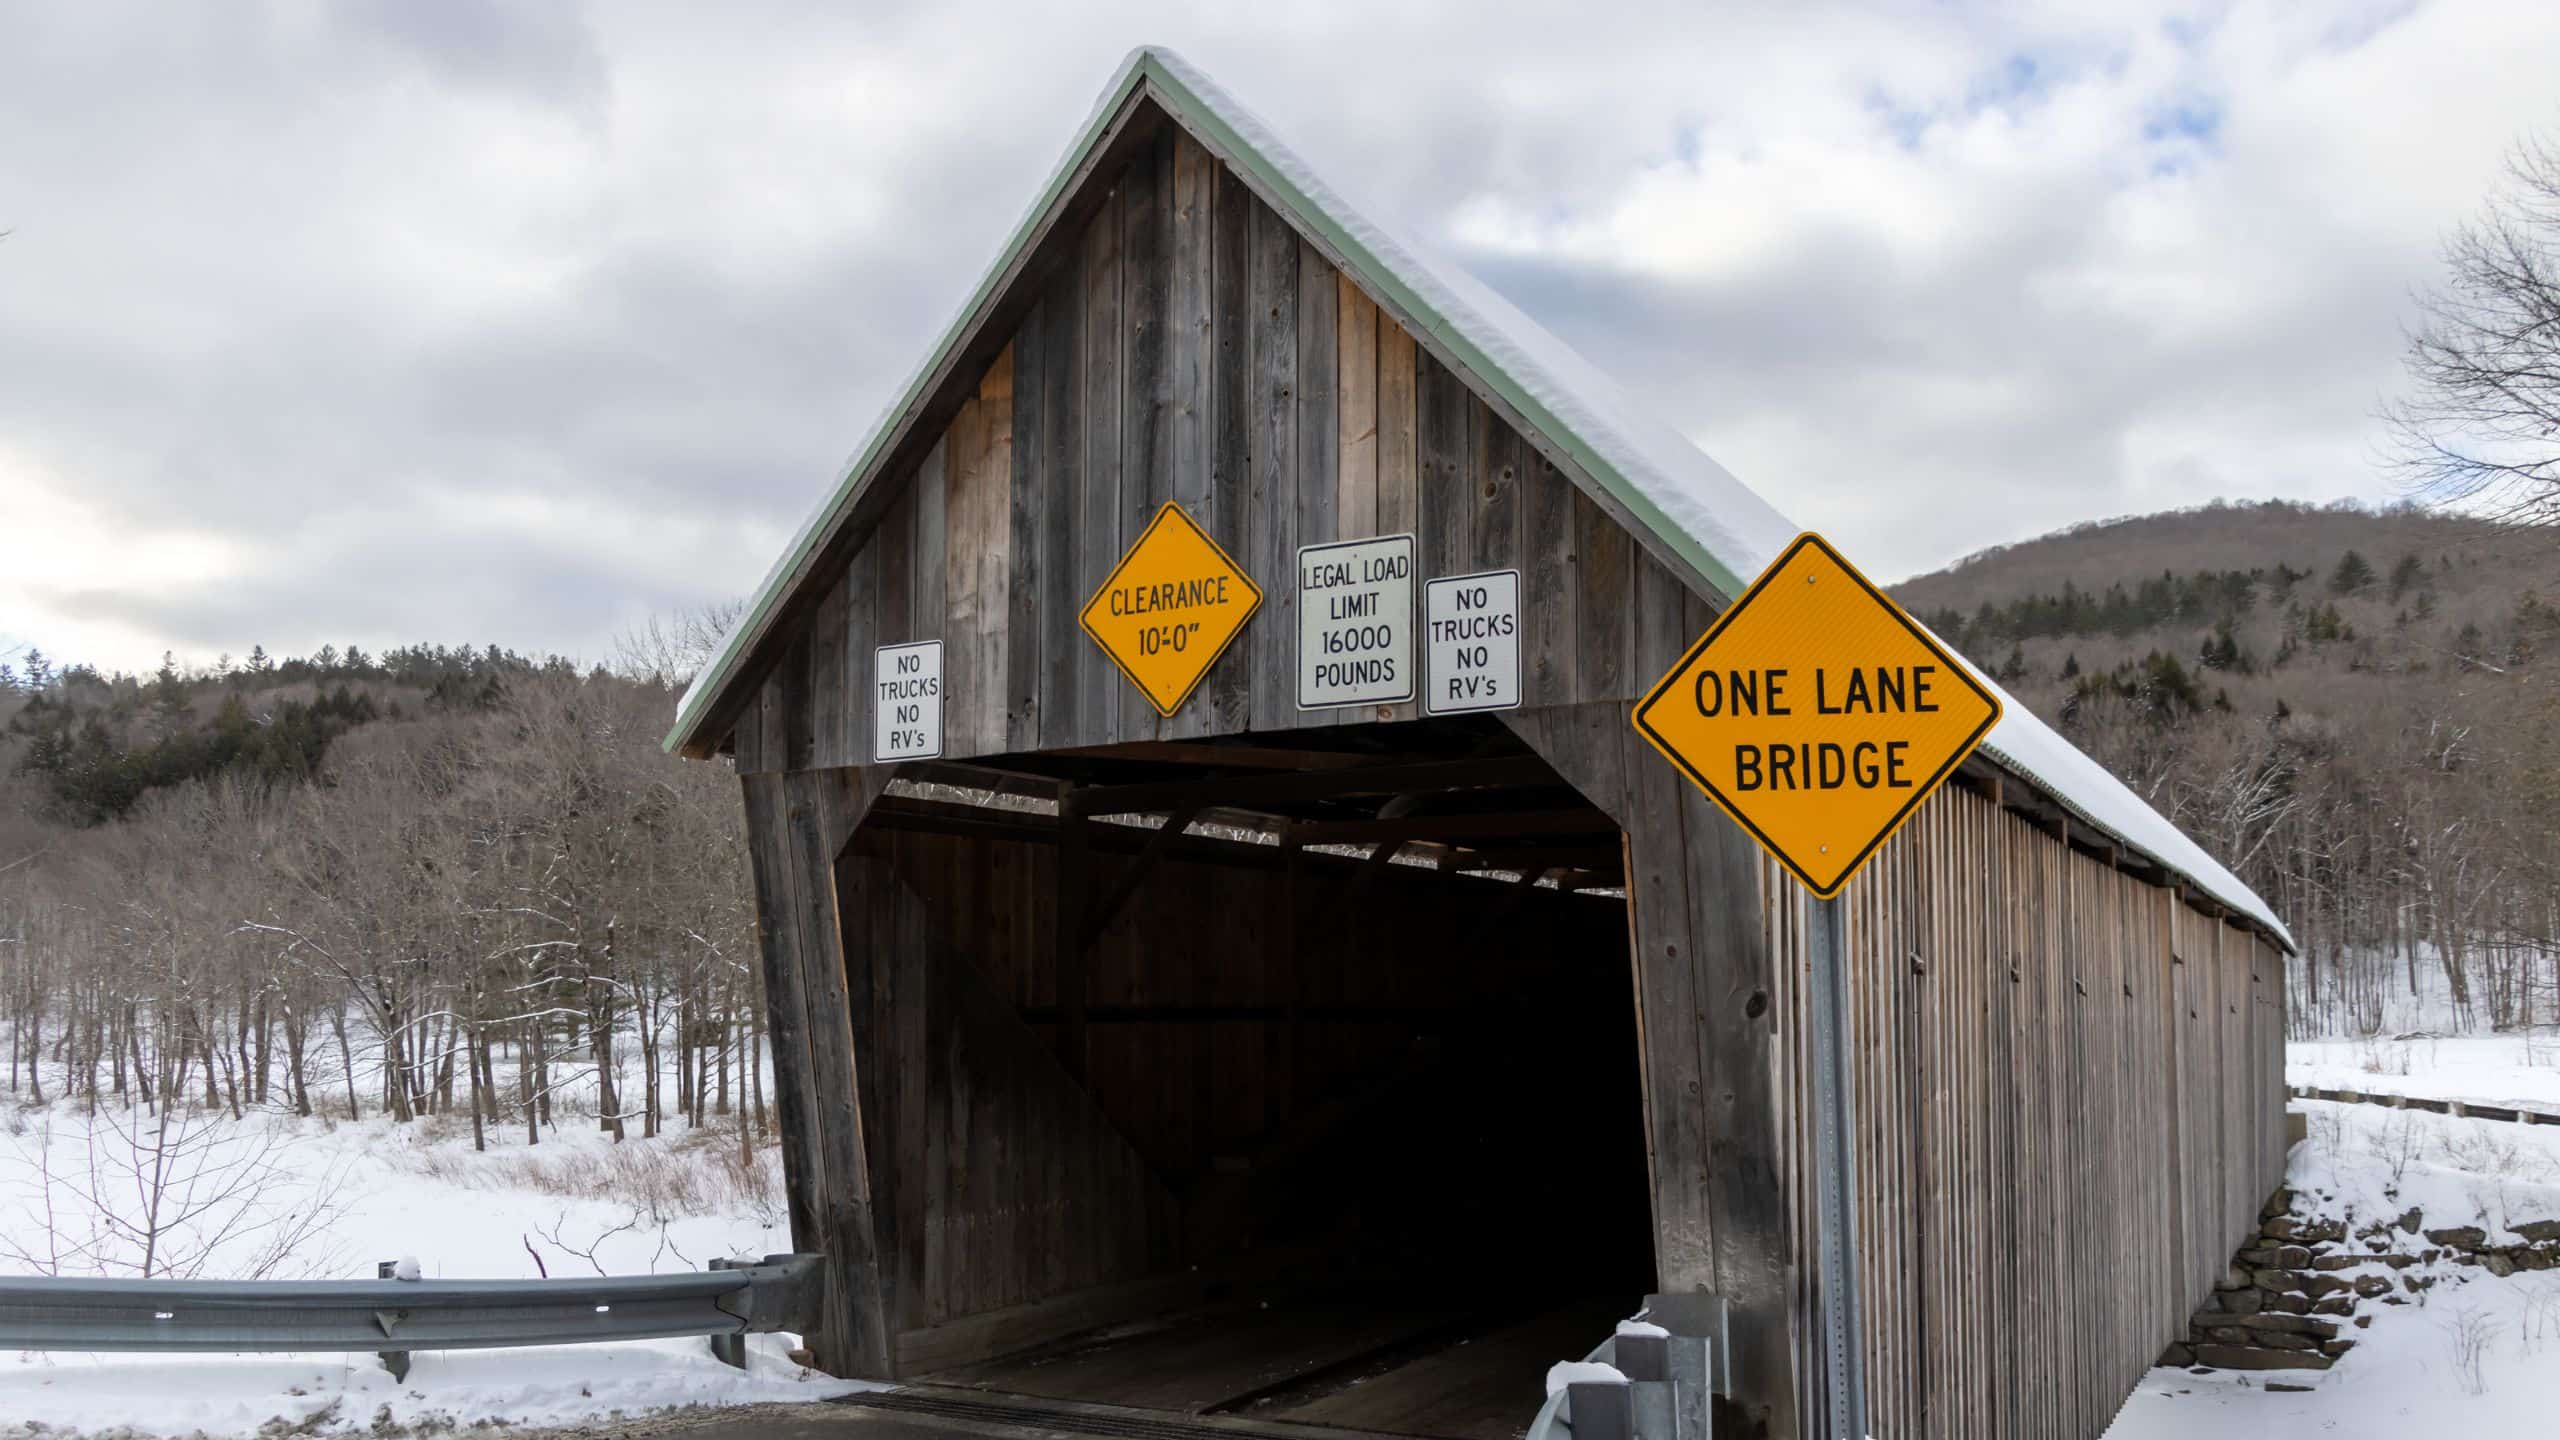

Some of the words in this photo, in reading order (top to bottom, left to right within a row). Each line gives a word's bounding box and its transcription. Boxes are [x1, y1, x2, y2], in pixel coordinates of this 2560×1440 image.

[1303, 564, 1355, 590] LEGAL
[1364, 555, 1409, 581] LOAD
[1111, 577, 1228, 616] CLEARANCE
[1330, 592, 1380, 620] LIMIT
[1457, 588, 1487, 610] NO
[1322, 625, 1392, 654] 16000
[1432, 614, 1514, 643] TRUCKS
[897, 654, 920, 674] NO
[1457, 646, 1487, 669] NO
[1315, 658, 1395, 689] POUNDS
[1449, 675, 1497, 700] RV's
[879, 677, 938, 701] TRUCKS
[1695, 669, 1791, 717] ONE
[1815, 665, 1939, 715] LANE
[896, 704, 919, 724] NO
[890, 729, 925, 750] RV's
[1735, 740, 1913, 792] BRIDGE
